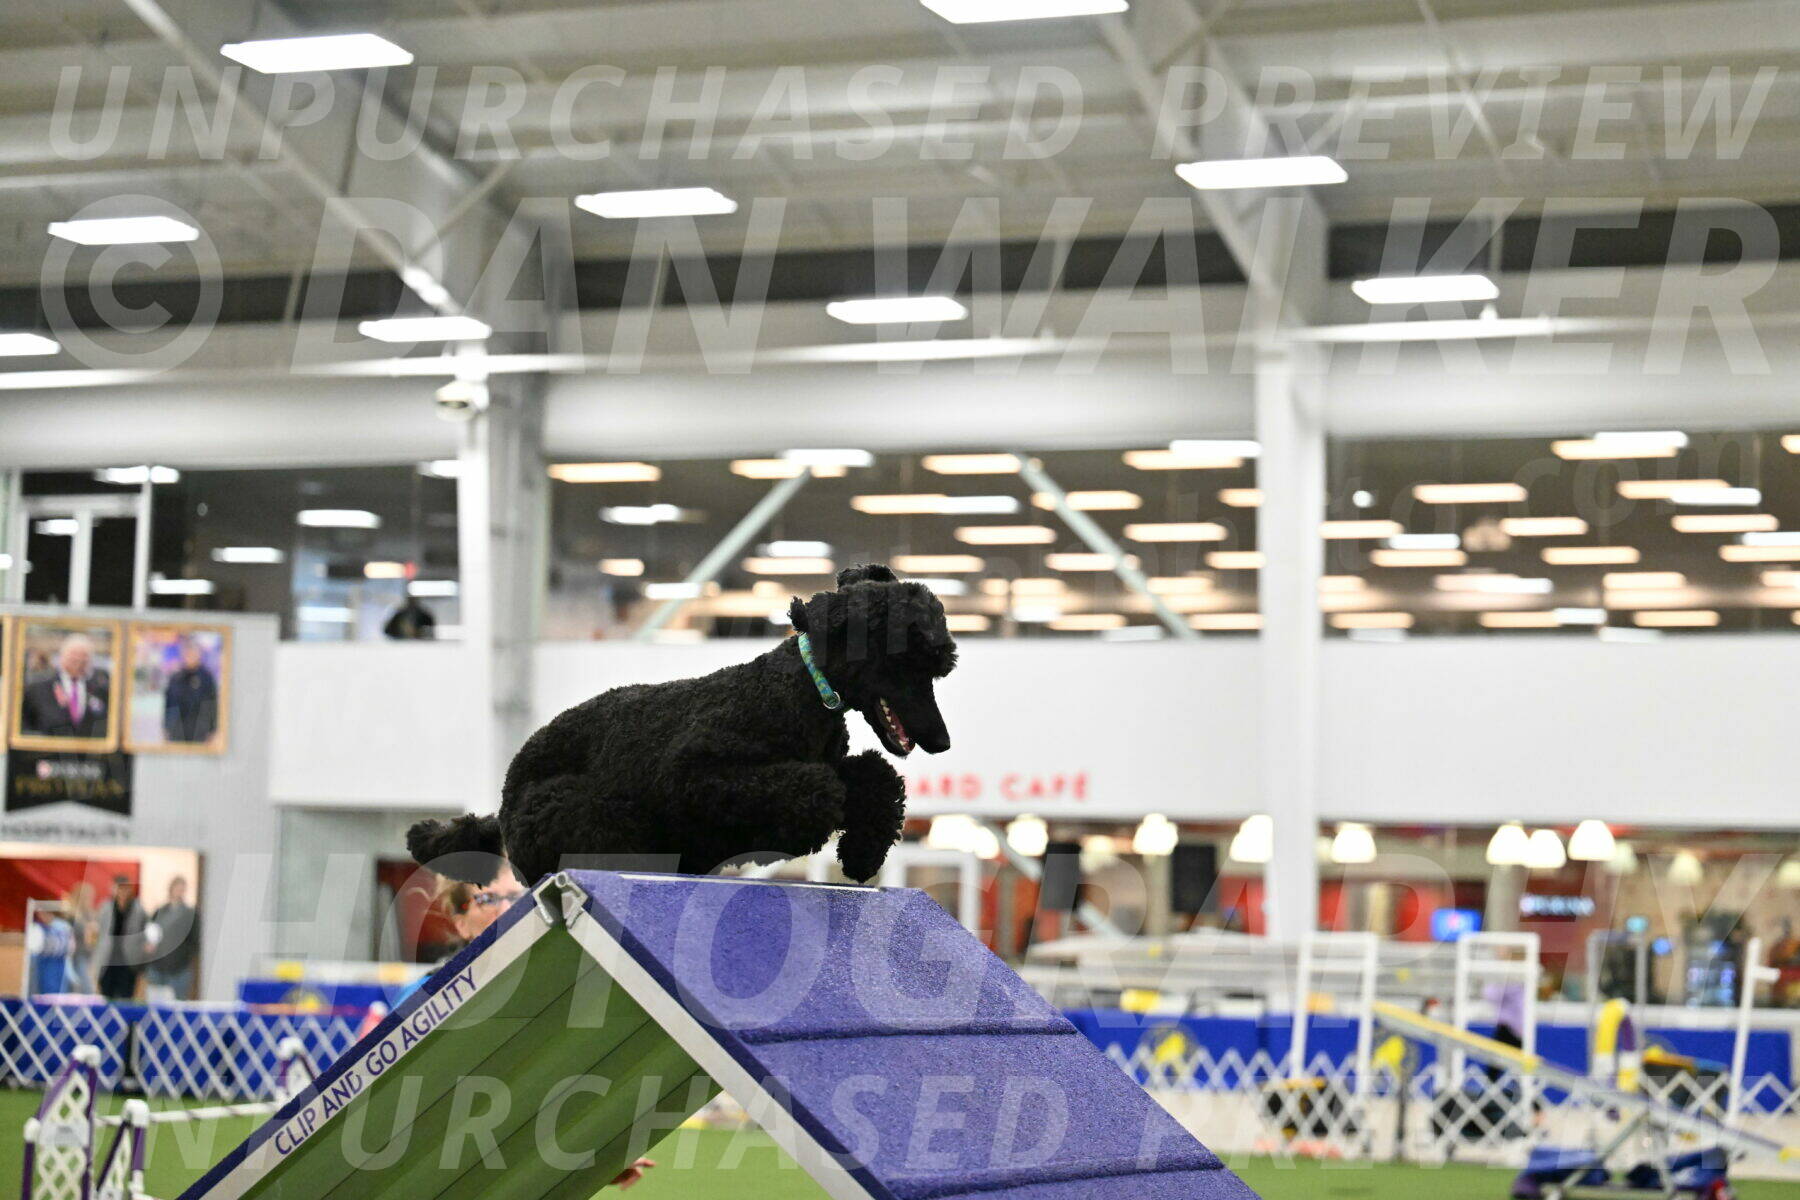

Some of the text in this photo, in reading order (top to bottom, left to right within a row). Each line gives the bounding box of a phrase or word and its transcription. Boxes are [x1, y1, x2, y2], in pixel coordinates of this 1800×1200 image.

[904, 773, 984, 801] ARD
[275, 966, 479, 1155] CLIP AND GO AGILITY
